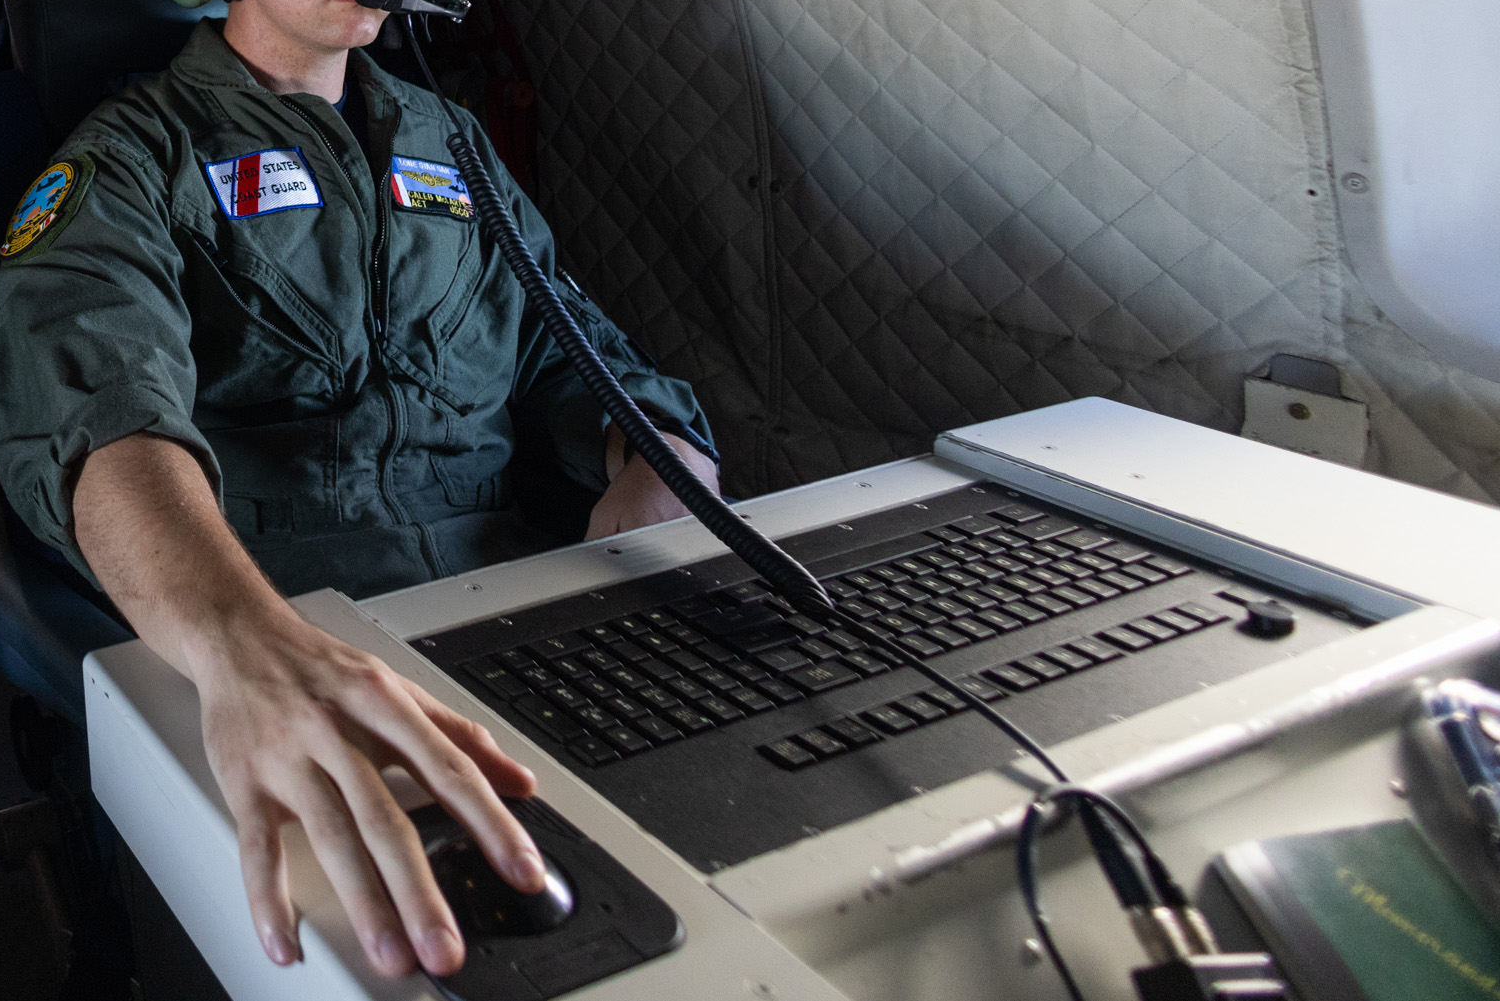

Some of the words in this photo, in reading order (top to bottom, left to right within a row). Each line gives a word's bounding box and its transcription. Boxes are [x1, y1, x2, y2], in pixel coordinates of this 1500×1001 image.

[220, 166, 258, 185] UNITED
[262, 160, 301, 174] STATES
[231, 185, 267, 204] COAST
[271, 180, 307, 195] GUARD
[407, 190, 434, 201] CALEB
[411, 198, 427, 208] AET
